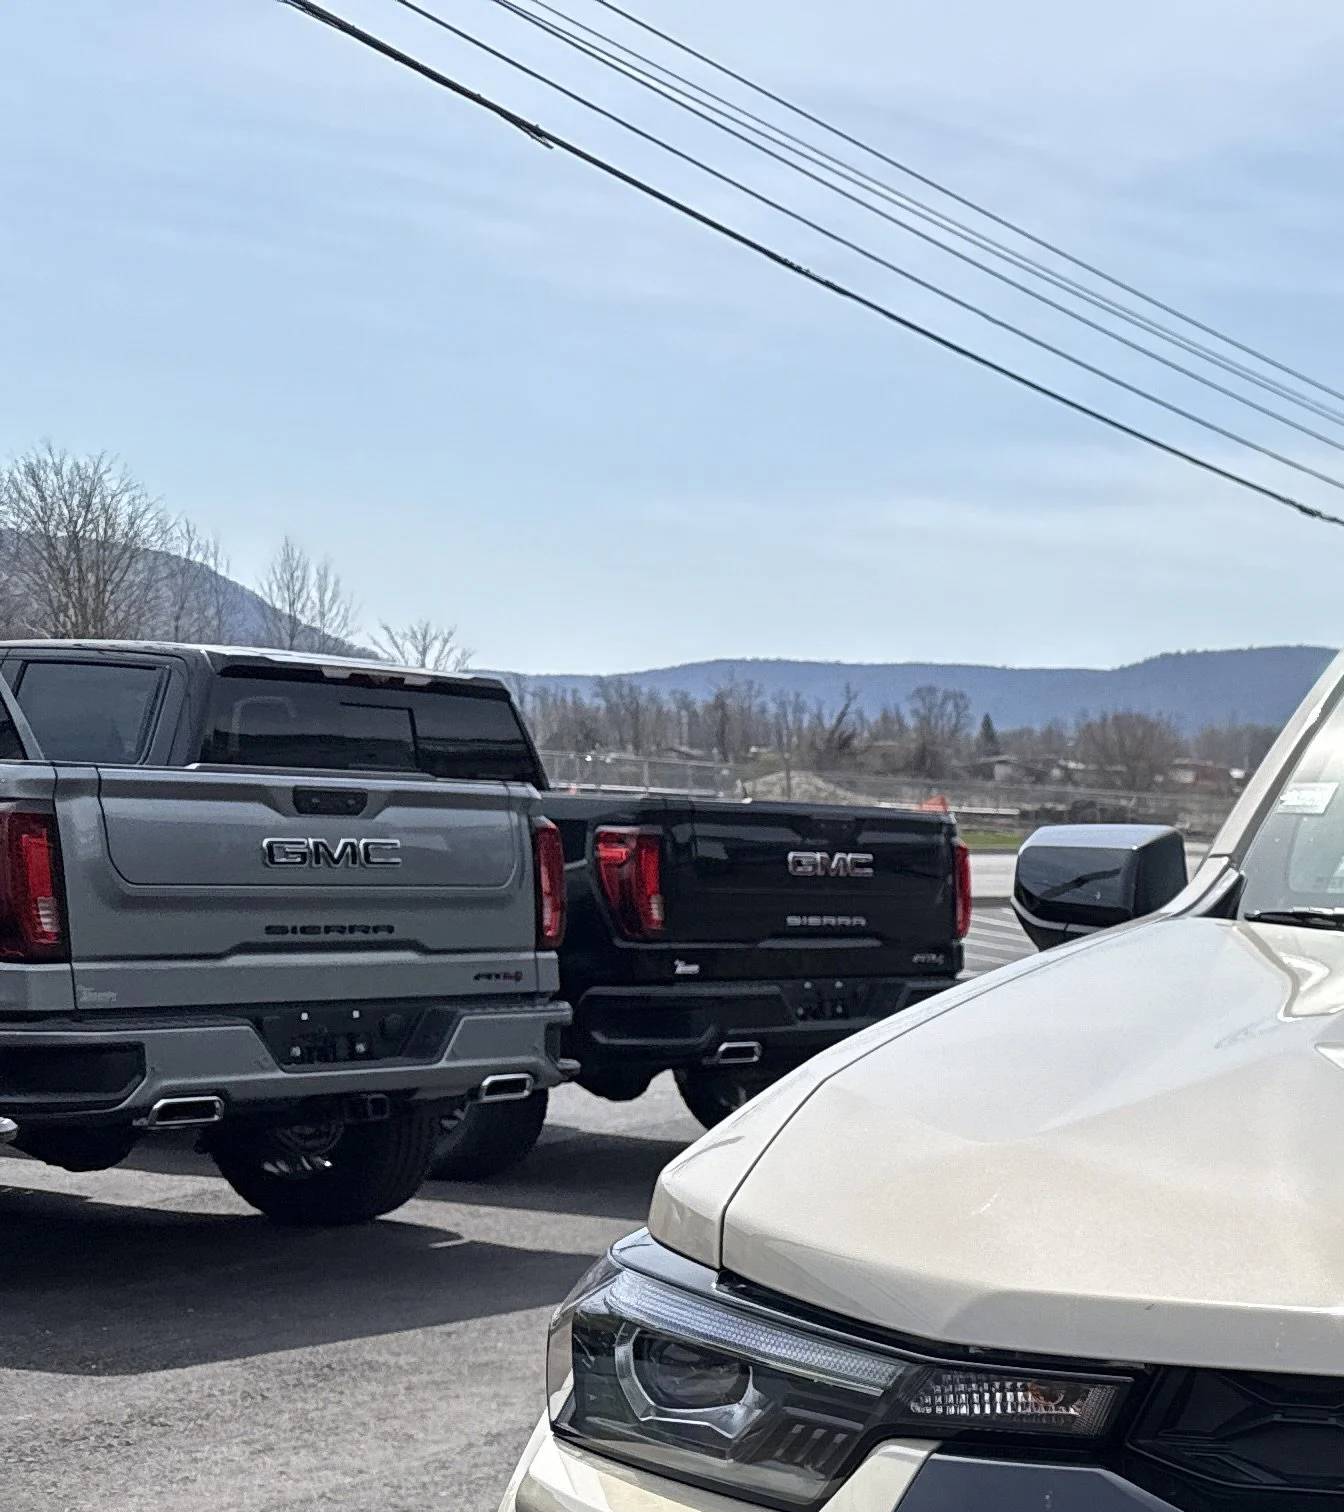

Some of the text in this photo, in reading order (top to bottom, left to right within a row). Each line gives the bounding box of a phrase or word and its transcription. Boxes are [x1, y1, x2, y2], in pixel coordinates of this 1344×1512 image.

[262, 837, 402, 869] GMC
[787, 850, 875, 878] GMC
[264, 924, 395, 936] SIERRA
[786, 915, 867, 927] SIERRA
